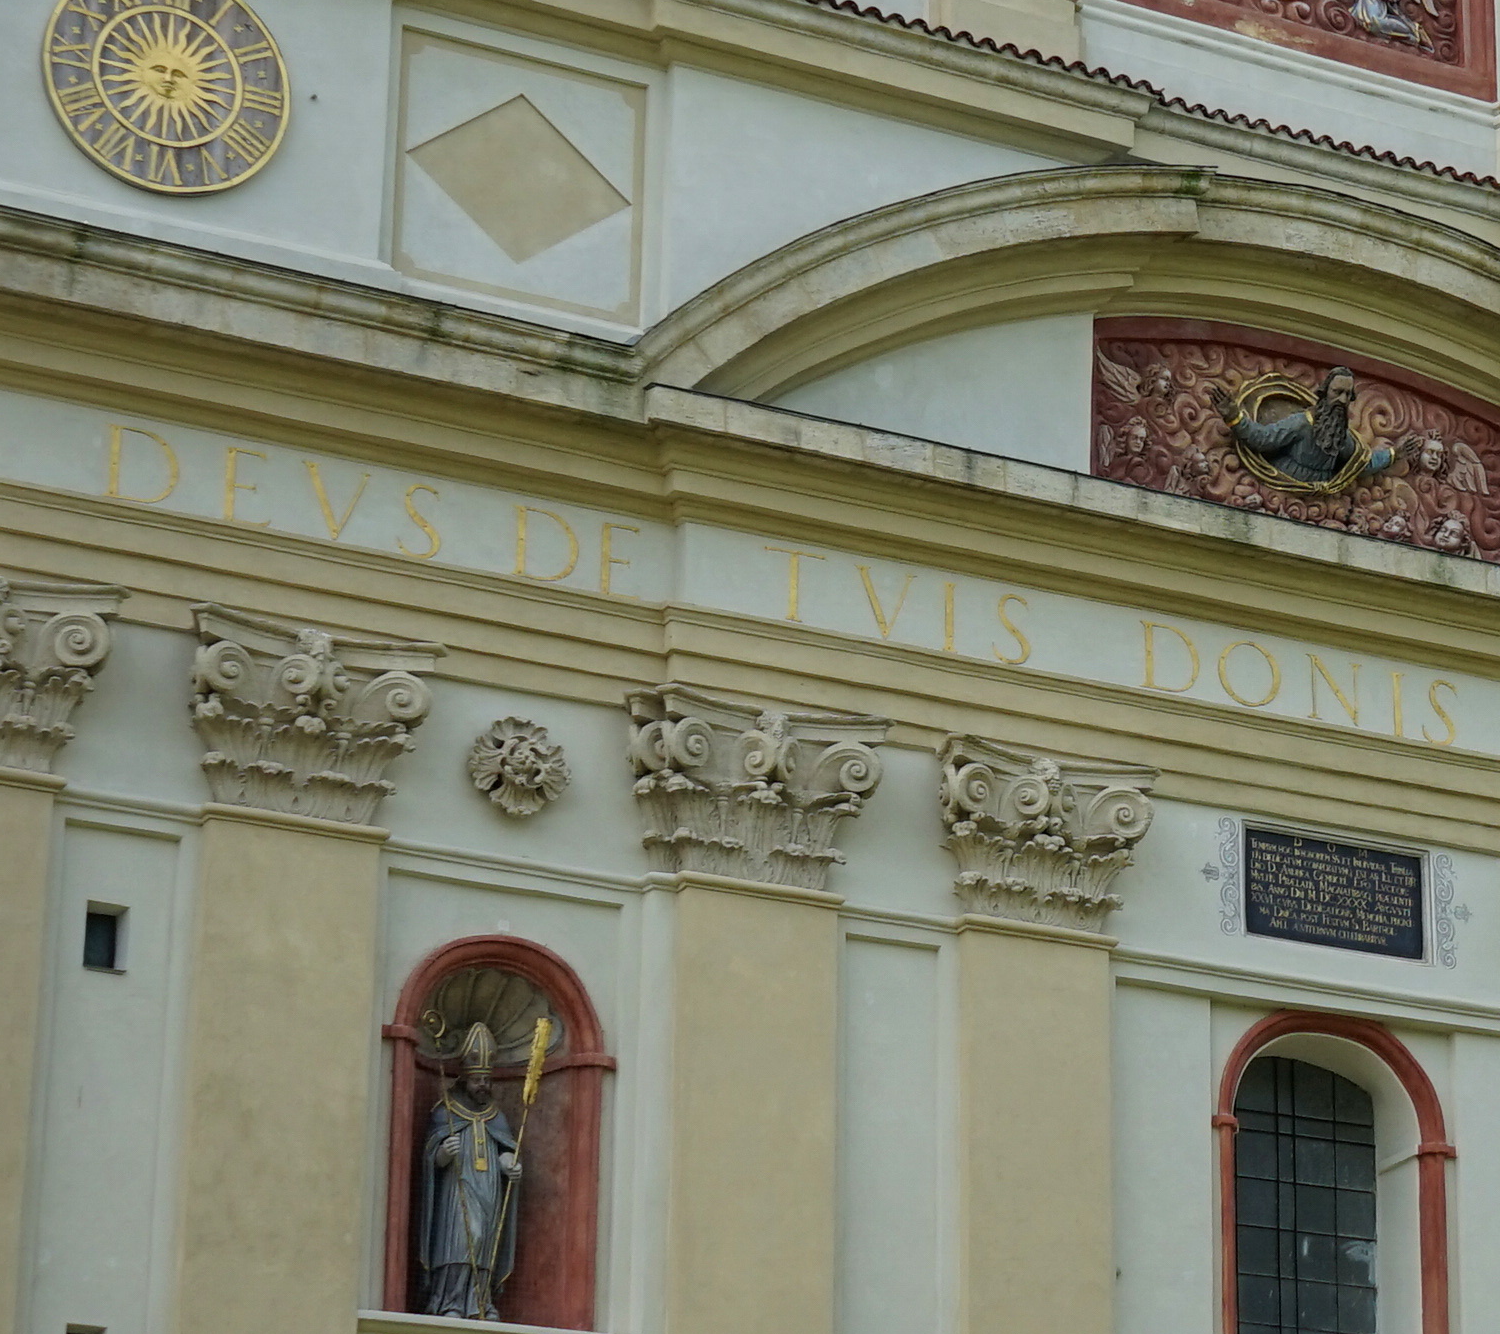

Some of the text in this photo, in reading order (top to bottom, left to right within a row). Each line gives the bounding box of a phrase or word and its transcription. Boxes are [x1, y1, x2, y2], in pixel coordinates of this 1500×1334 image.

[101, 423, 441, 559] DEVS
[513, 504, 640, 600] DE
[764, 545, 1031, 665] TVIS
[1139, 619, 1458, 746] DONIS
